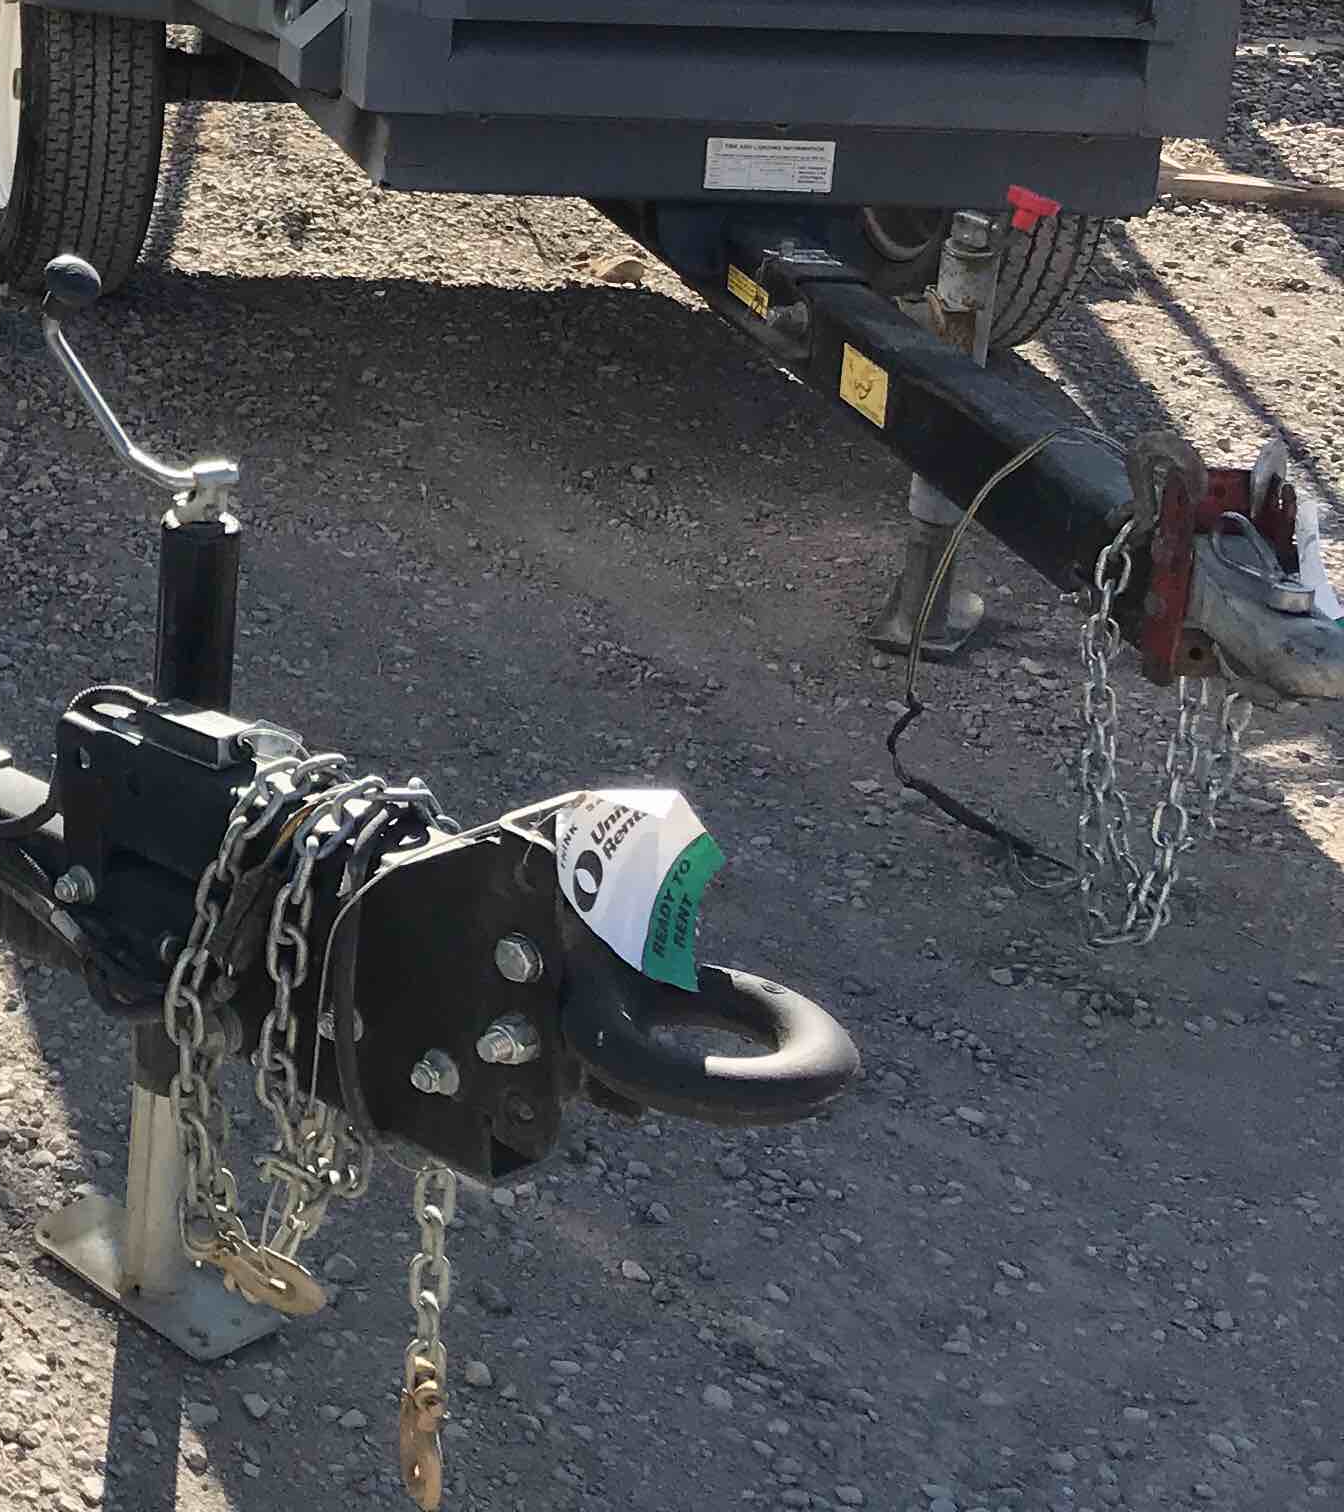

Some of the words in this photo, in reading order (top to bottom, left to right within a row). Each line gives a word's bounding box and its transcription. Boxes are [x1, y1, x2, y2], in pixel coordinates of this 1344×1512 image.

[651, 889, 678, 958] READY
[672, 858, 692, 884] TO
[673, 892, 696, 950] RENT
